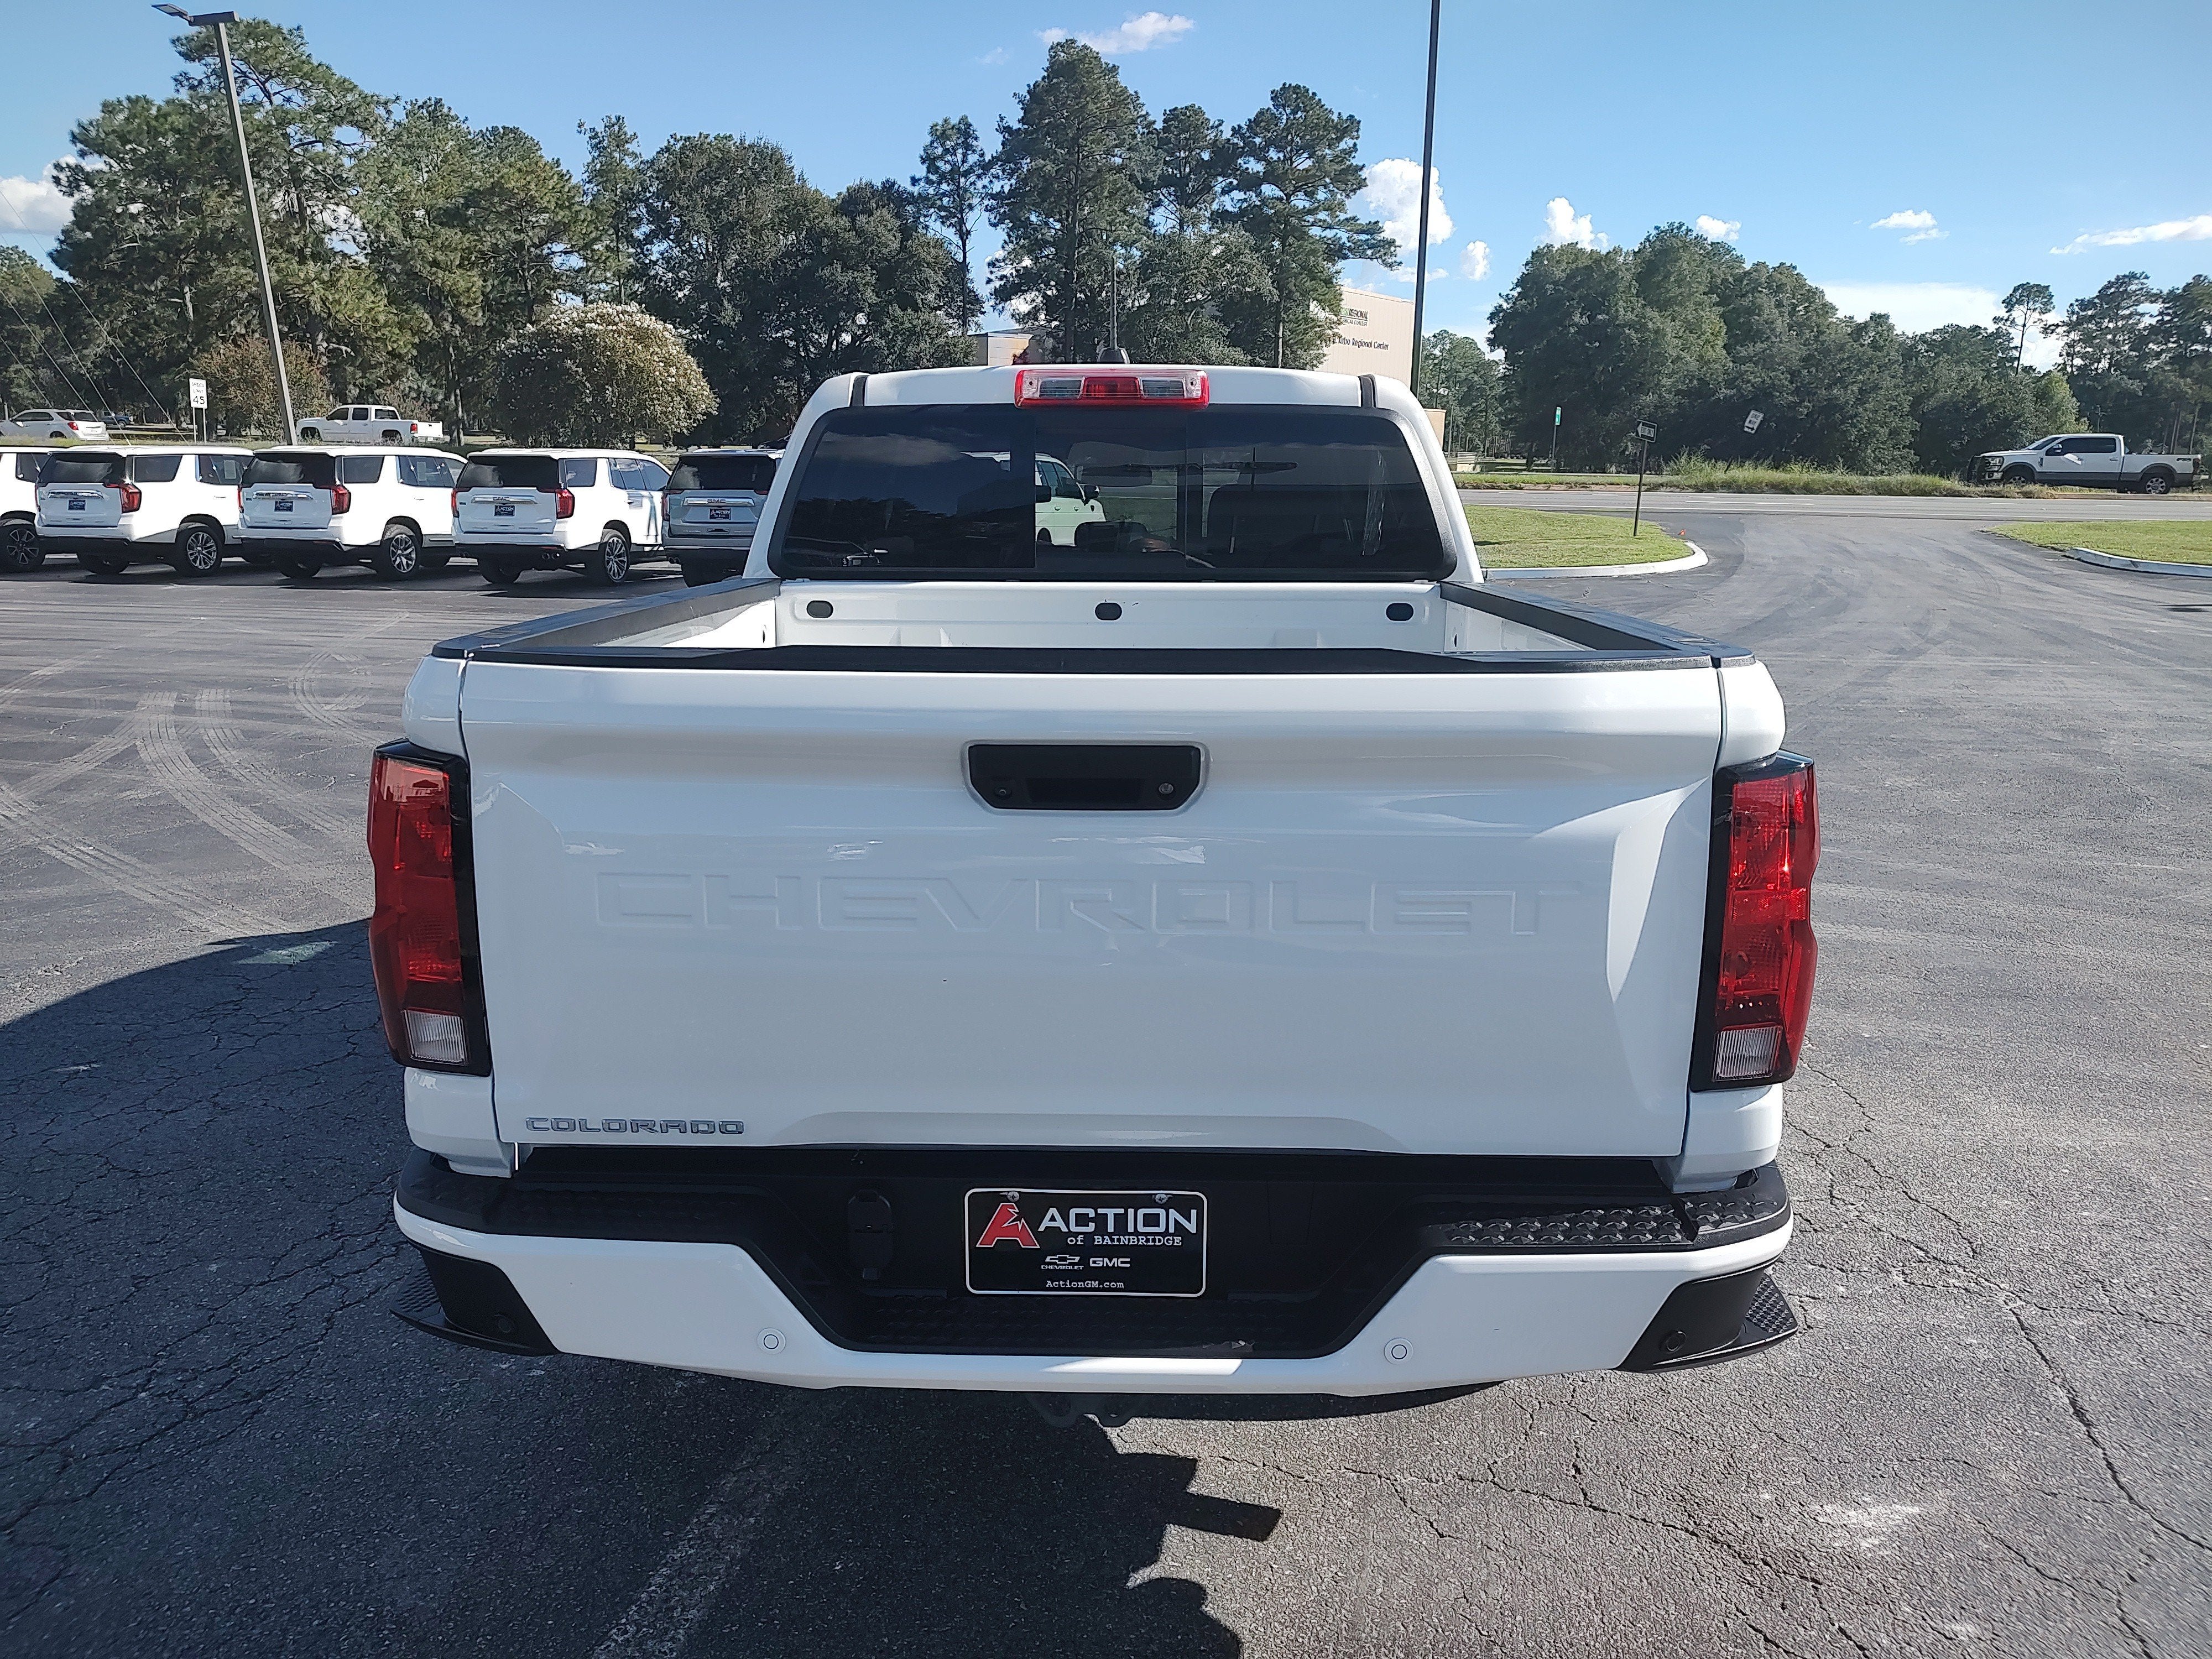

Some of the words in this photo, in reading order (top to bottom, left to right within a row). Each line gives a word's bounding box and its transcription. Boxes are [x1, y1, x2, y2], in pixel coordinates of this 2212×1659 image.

[1352, 338, 1373, 348] Regional
[1374, 341, 1389, 351] Center
[193, 396, 205, 404] 45
[595, 871, 1582, 936] CHEVROLET
[525, 1117, 744, 1135] COLORADO
[1037, 1207, 1197, 1234] ACTION
[1067, 1235, 1084, 1245] of
[1093, 1235, 1182, 1246] BAINBRIDGE
[1089, 1257, 1131, 1267] GMC
[1045, 1279, 1125, 1289] ActionGM.com
